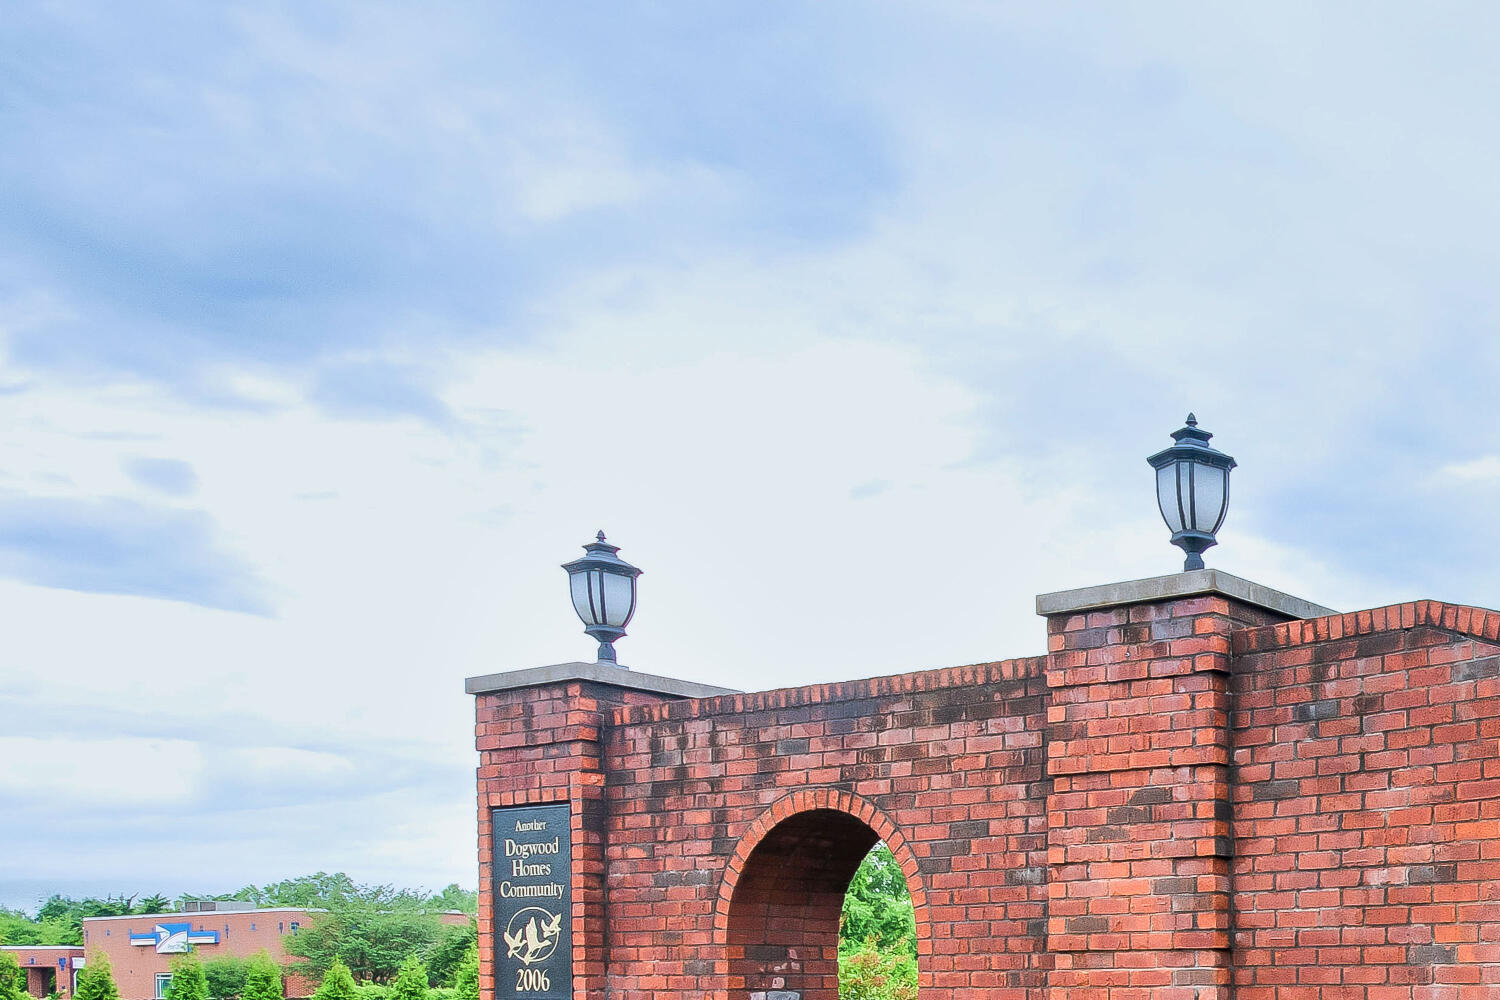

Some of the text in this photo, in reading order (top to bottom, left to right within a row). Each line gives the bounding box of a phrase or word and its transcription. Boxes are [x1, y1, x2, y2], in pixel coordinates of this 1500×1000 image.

[515, 819, 547, 832] Another
[504, 837, 559, 859] Dogwood
[512, 859, 551, 877] Homes
[500, 881, 565, 900] Community
[515, 968, 550, 992] 2006
